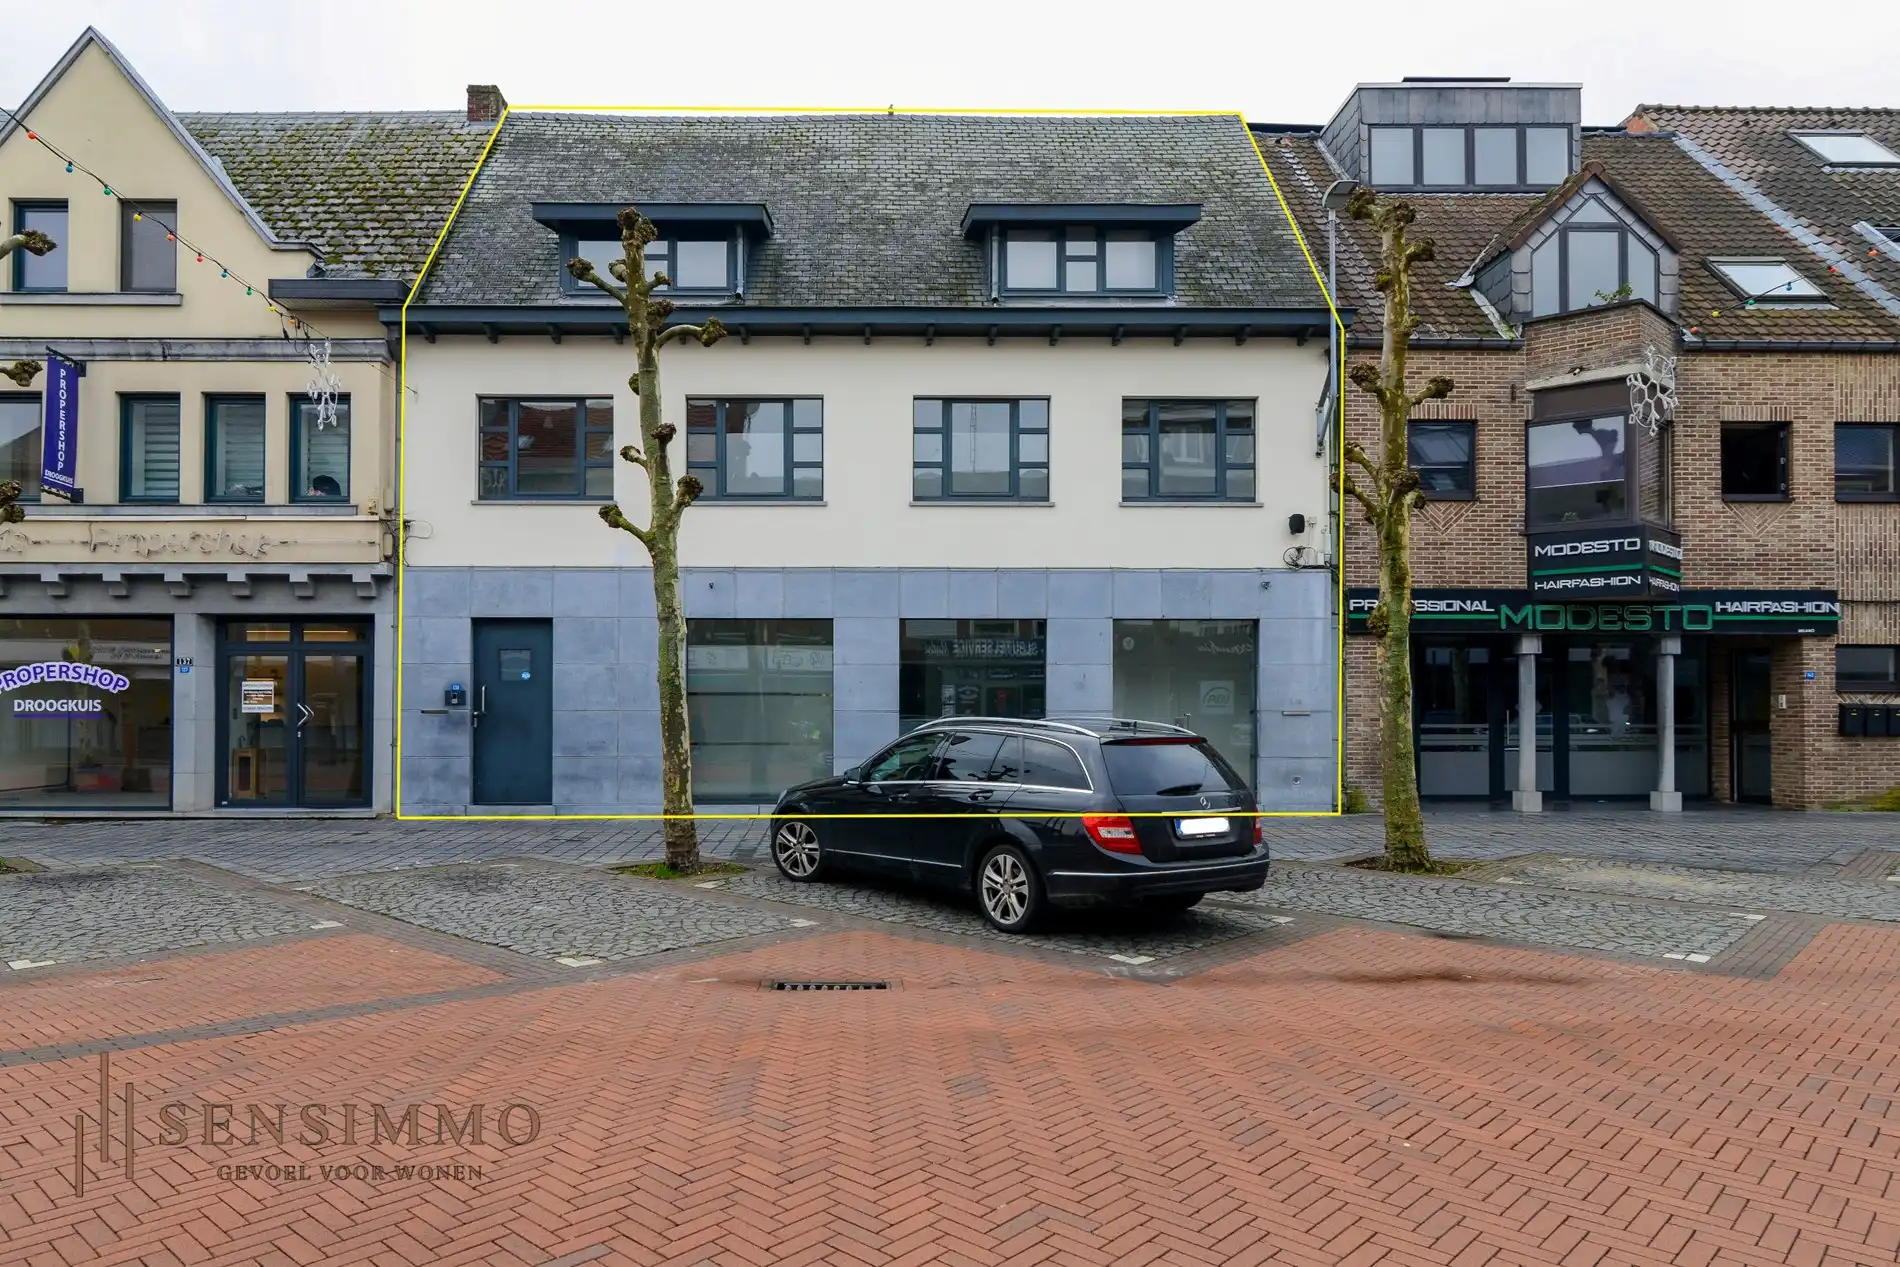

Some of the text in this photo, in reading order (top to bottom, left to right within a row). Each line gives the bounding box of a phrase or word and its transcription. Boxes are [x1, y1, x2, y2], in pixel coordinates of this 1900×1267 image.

[58, 368, 67, 471] PROPERSHOP
[1534, 538, 1641, 557] MODESTO
[1534, 575, 1641, 590] HAIRFASHION
[1349, 599, 1495, 612] PRSSIONAL
[1715, 601, 1840, 613] HAIRFASHION
[1500, 604, 1713, 630] MODESTO
[0, 663, 129, 694] ROPERSHOP
[13, 699, 102, 712] DROOGKUIS
